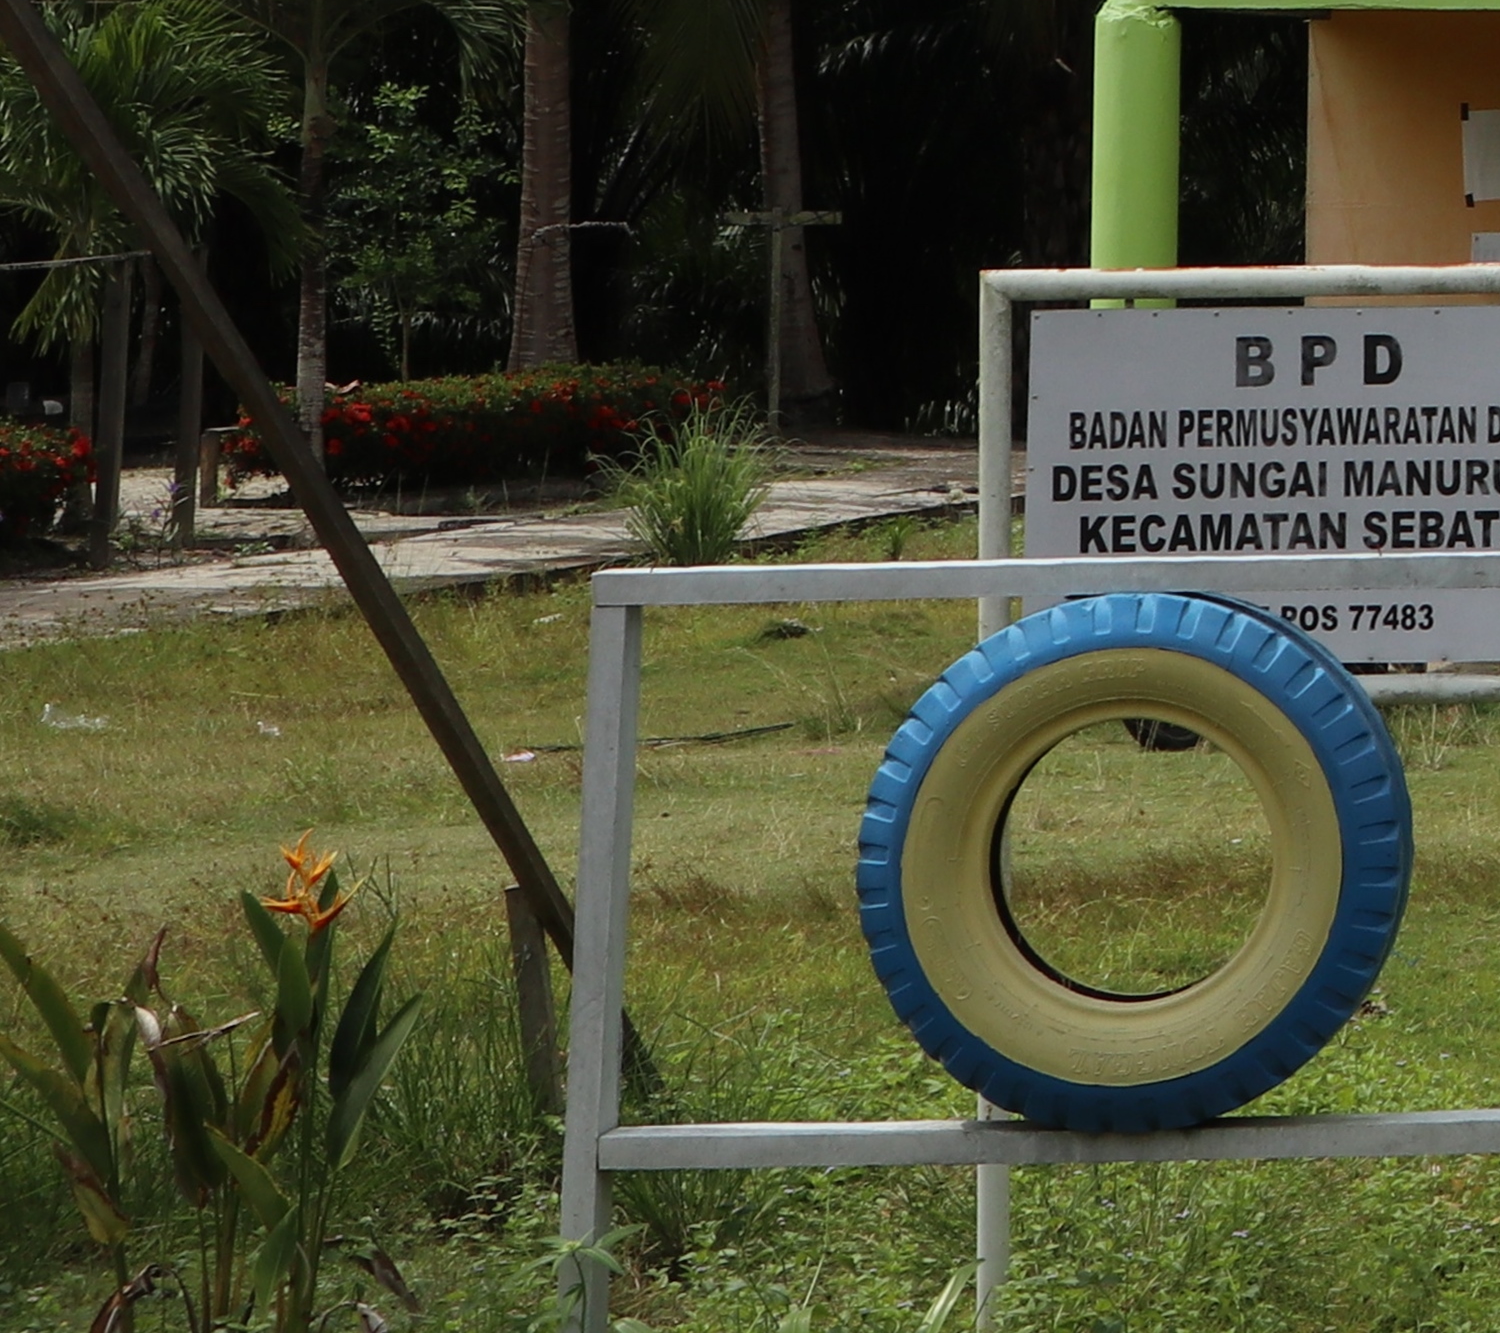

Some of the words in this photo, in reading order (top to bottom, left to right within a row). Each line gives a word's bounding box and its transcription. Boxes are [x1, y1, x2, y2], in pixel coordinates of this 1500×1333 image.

[1069, 410, 1169, 451] BADAN
[1179, 407, 1480, 449] PERMUSYAWARATAN
[1052, 461, 1160, 502] DESA
[1171, 458, 1329, 500] SUNGAI
[1079, 510, 1347, 555] KECAMATAN
[1348, 603, 1434, 631] 77483
